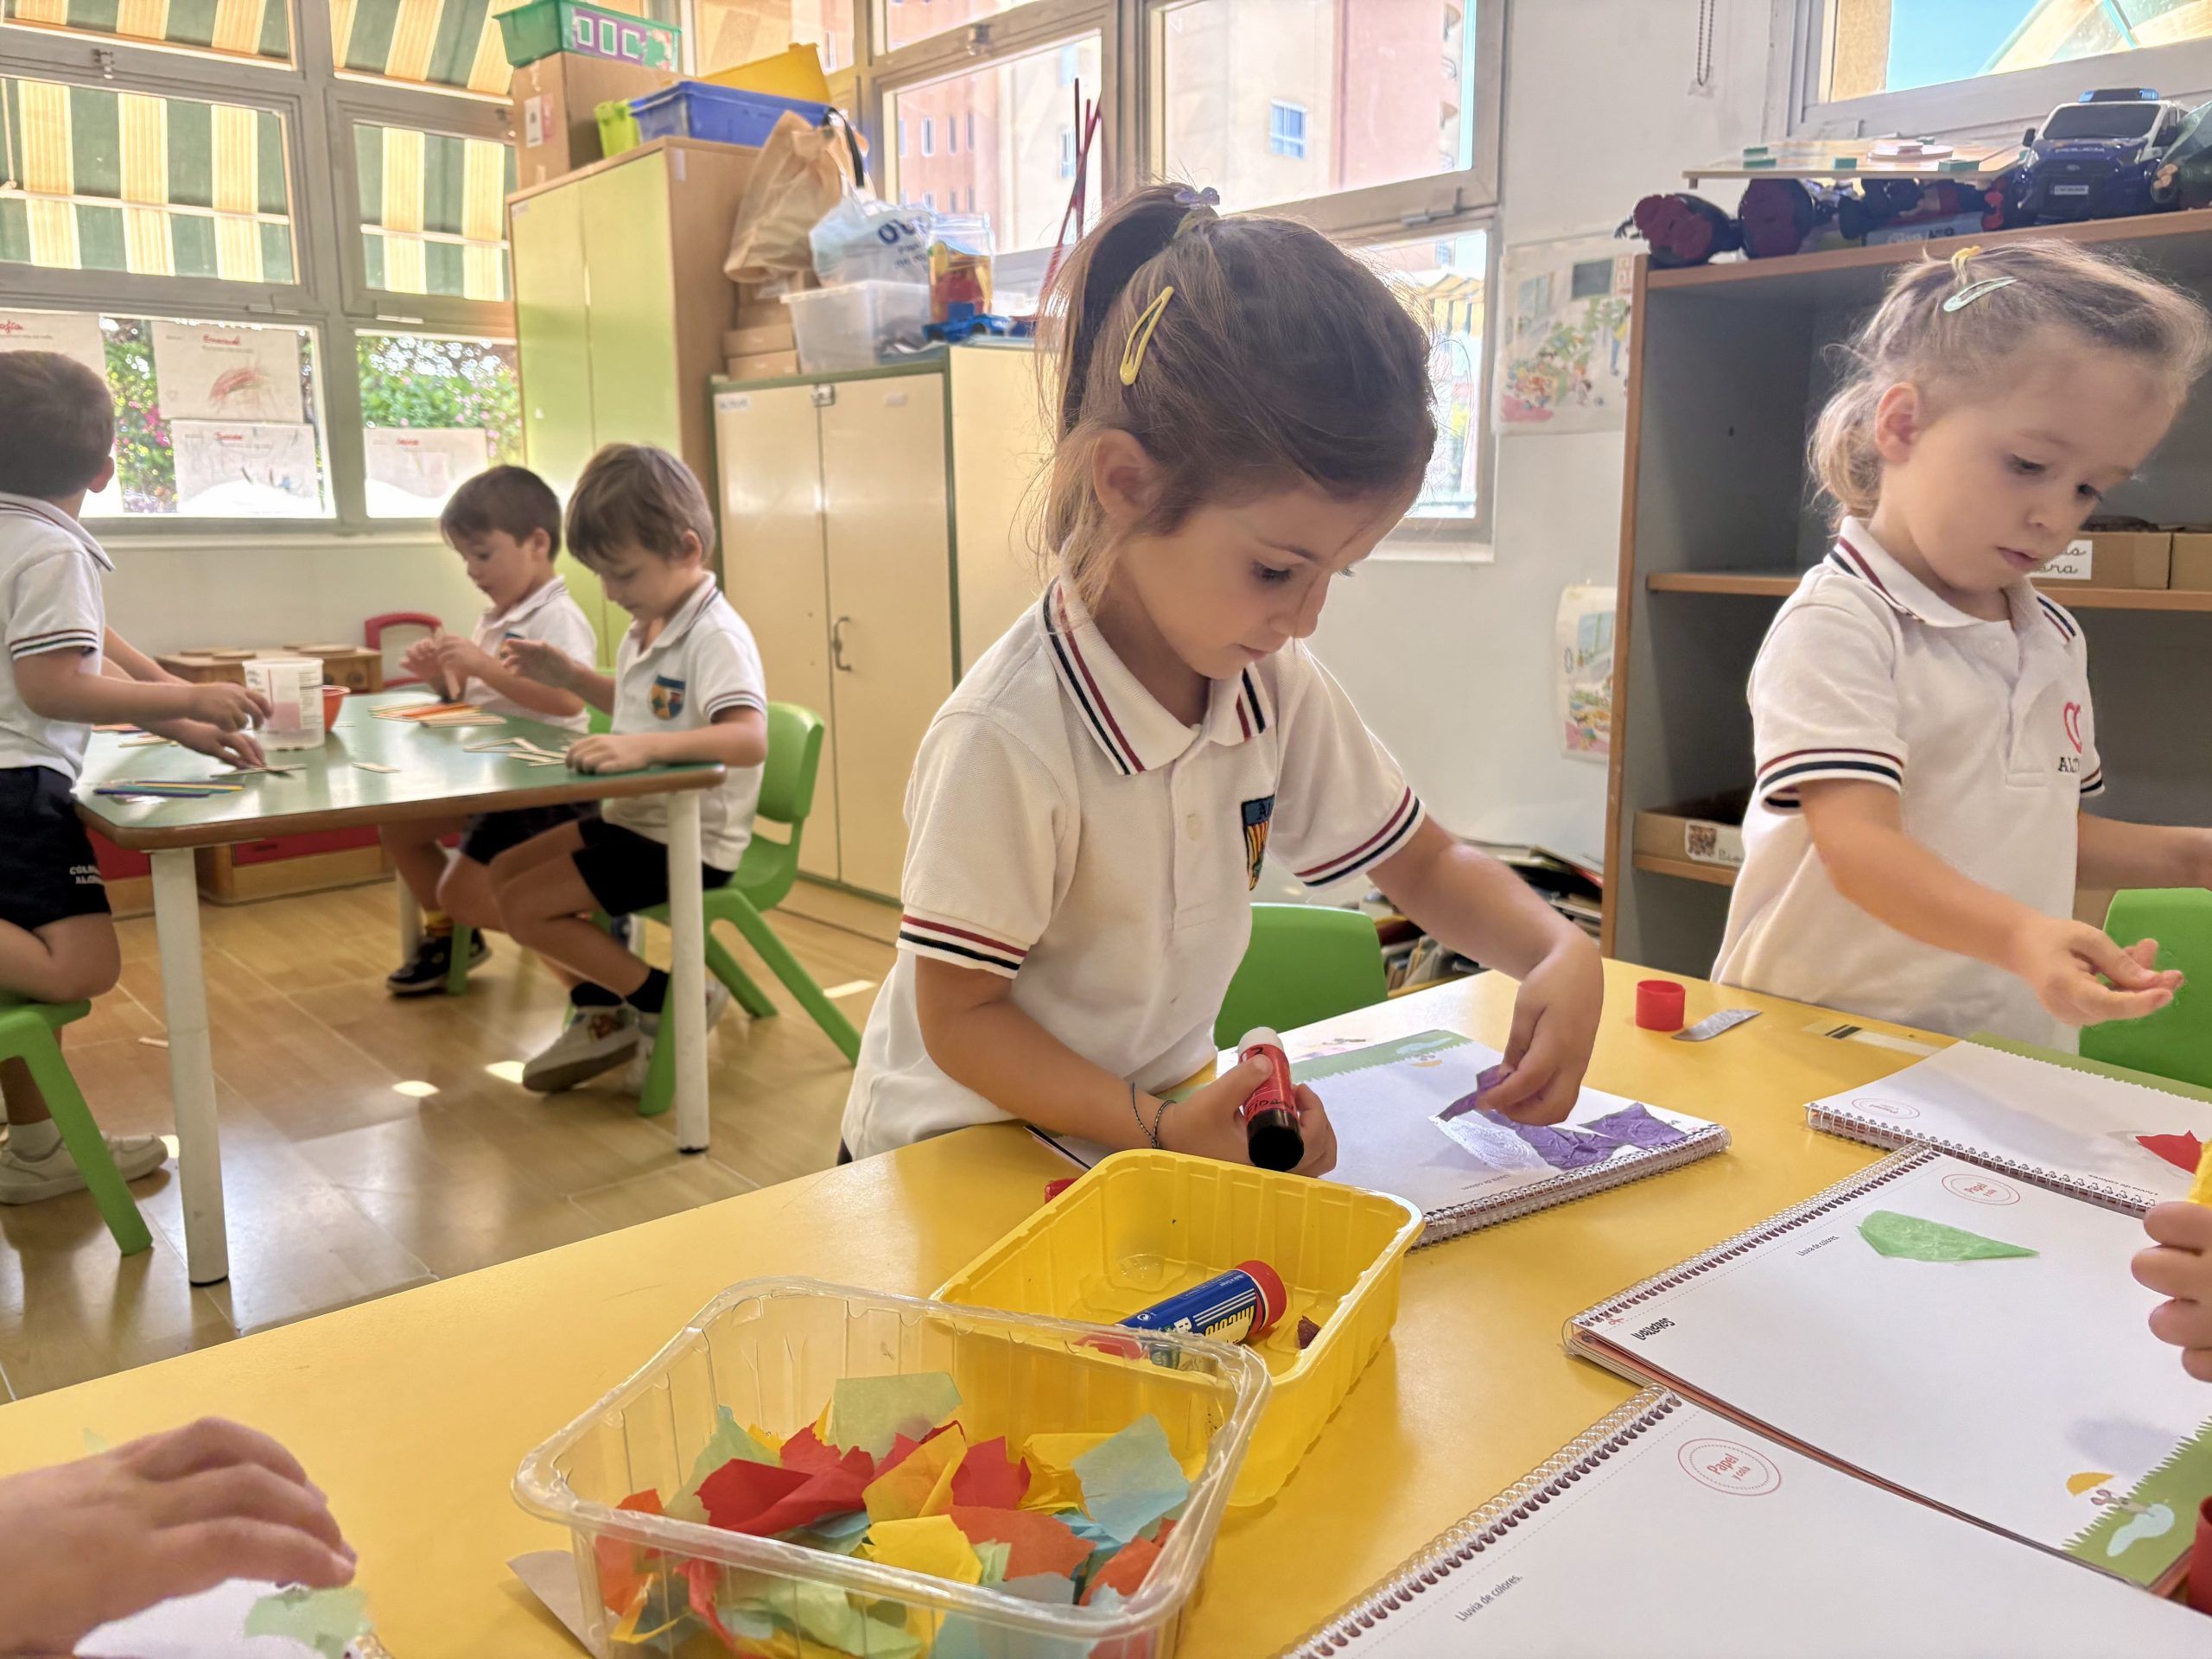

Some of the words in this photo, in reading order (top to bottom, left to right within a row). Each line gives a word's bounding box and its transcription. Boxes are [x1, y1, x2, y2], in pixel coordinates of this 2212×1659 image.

[1707, 1452, 1739, 1476] Papel
[1454, 1601, 1484, 1622] Lluvia
[1479, 1593, 1495, 1605] de
